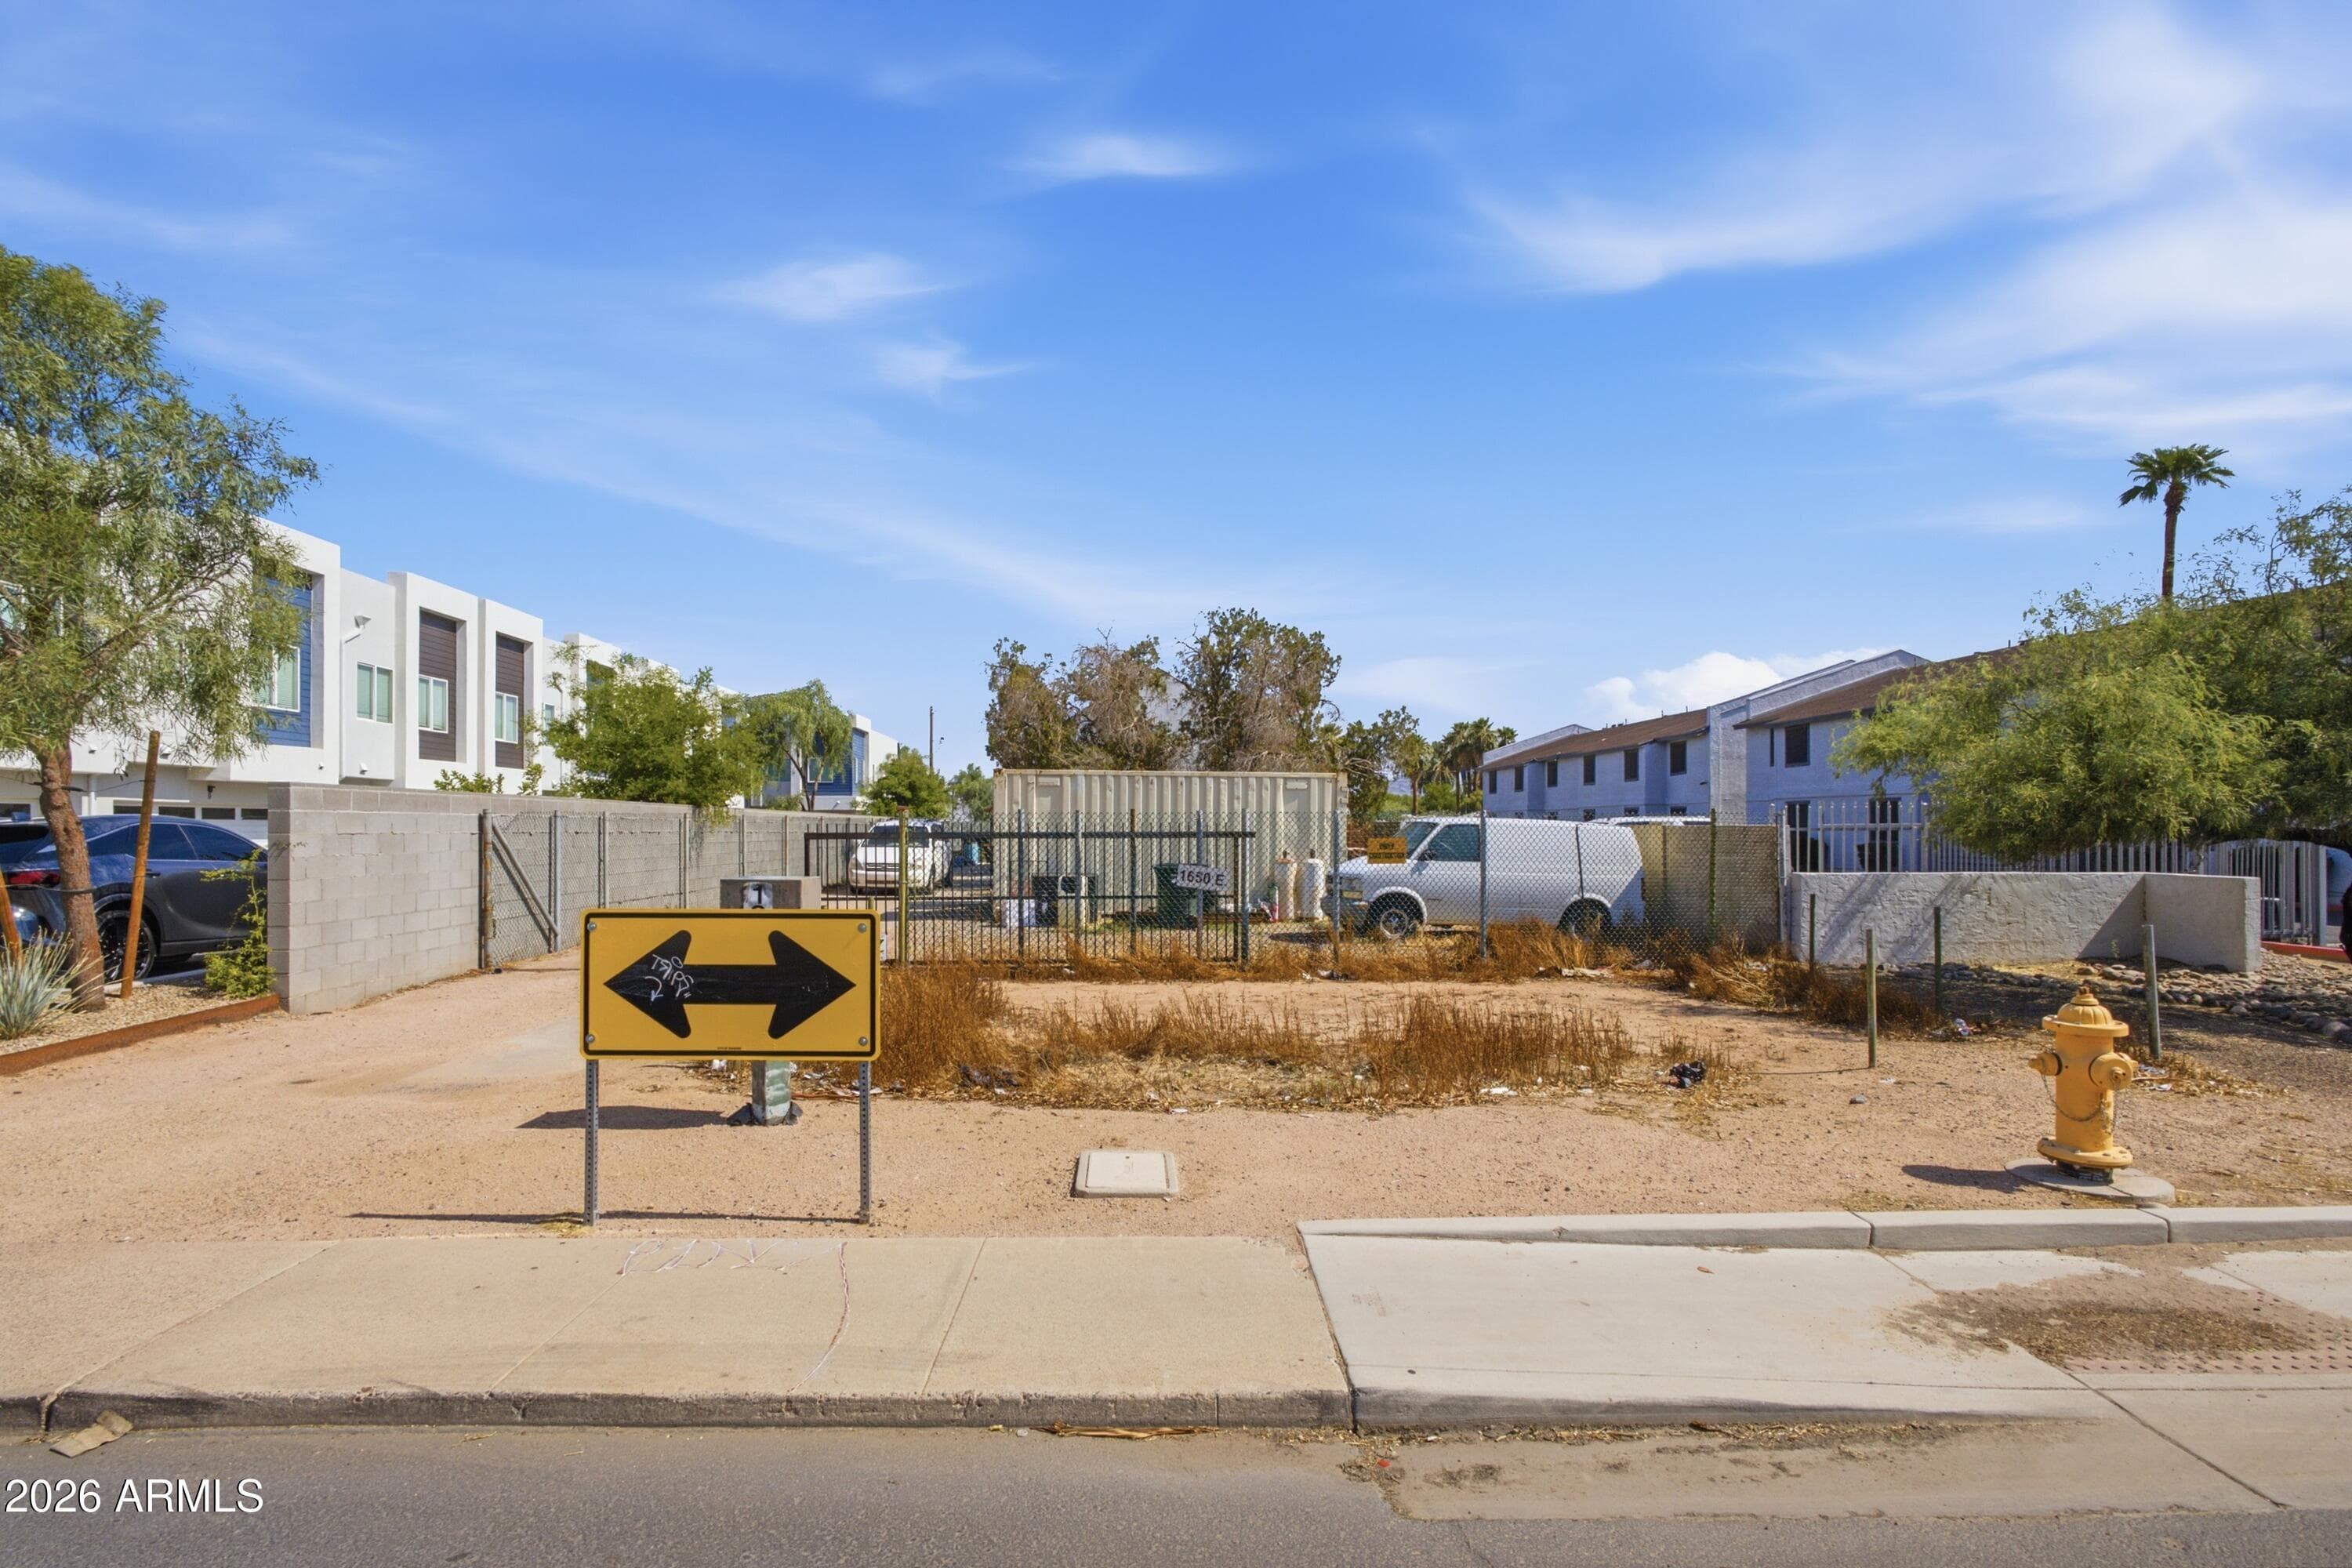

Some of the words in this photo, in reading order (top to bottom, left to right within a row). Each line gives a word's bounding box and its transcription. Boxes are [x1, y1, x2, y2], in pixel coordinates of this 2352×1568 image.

[1180, 869, 1211, 884] 1650
[1215, 873, 1225, 886] E
[752, 884, 765, 909] 1
